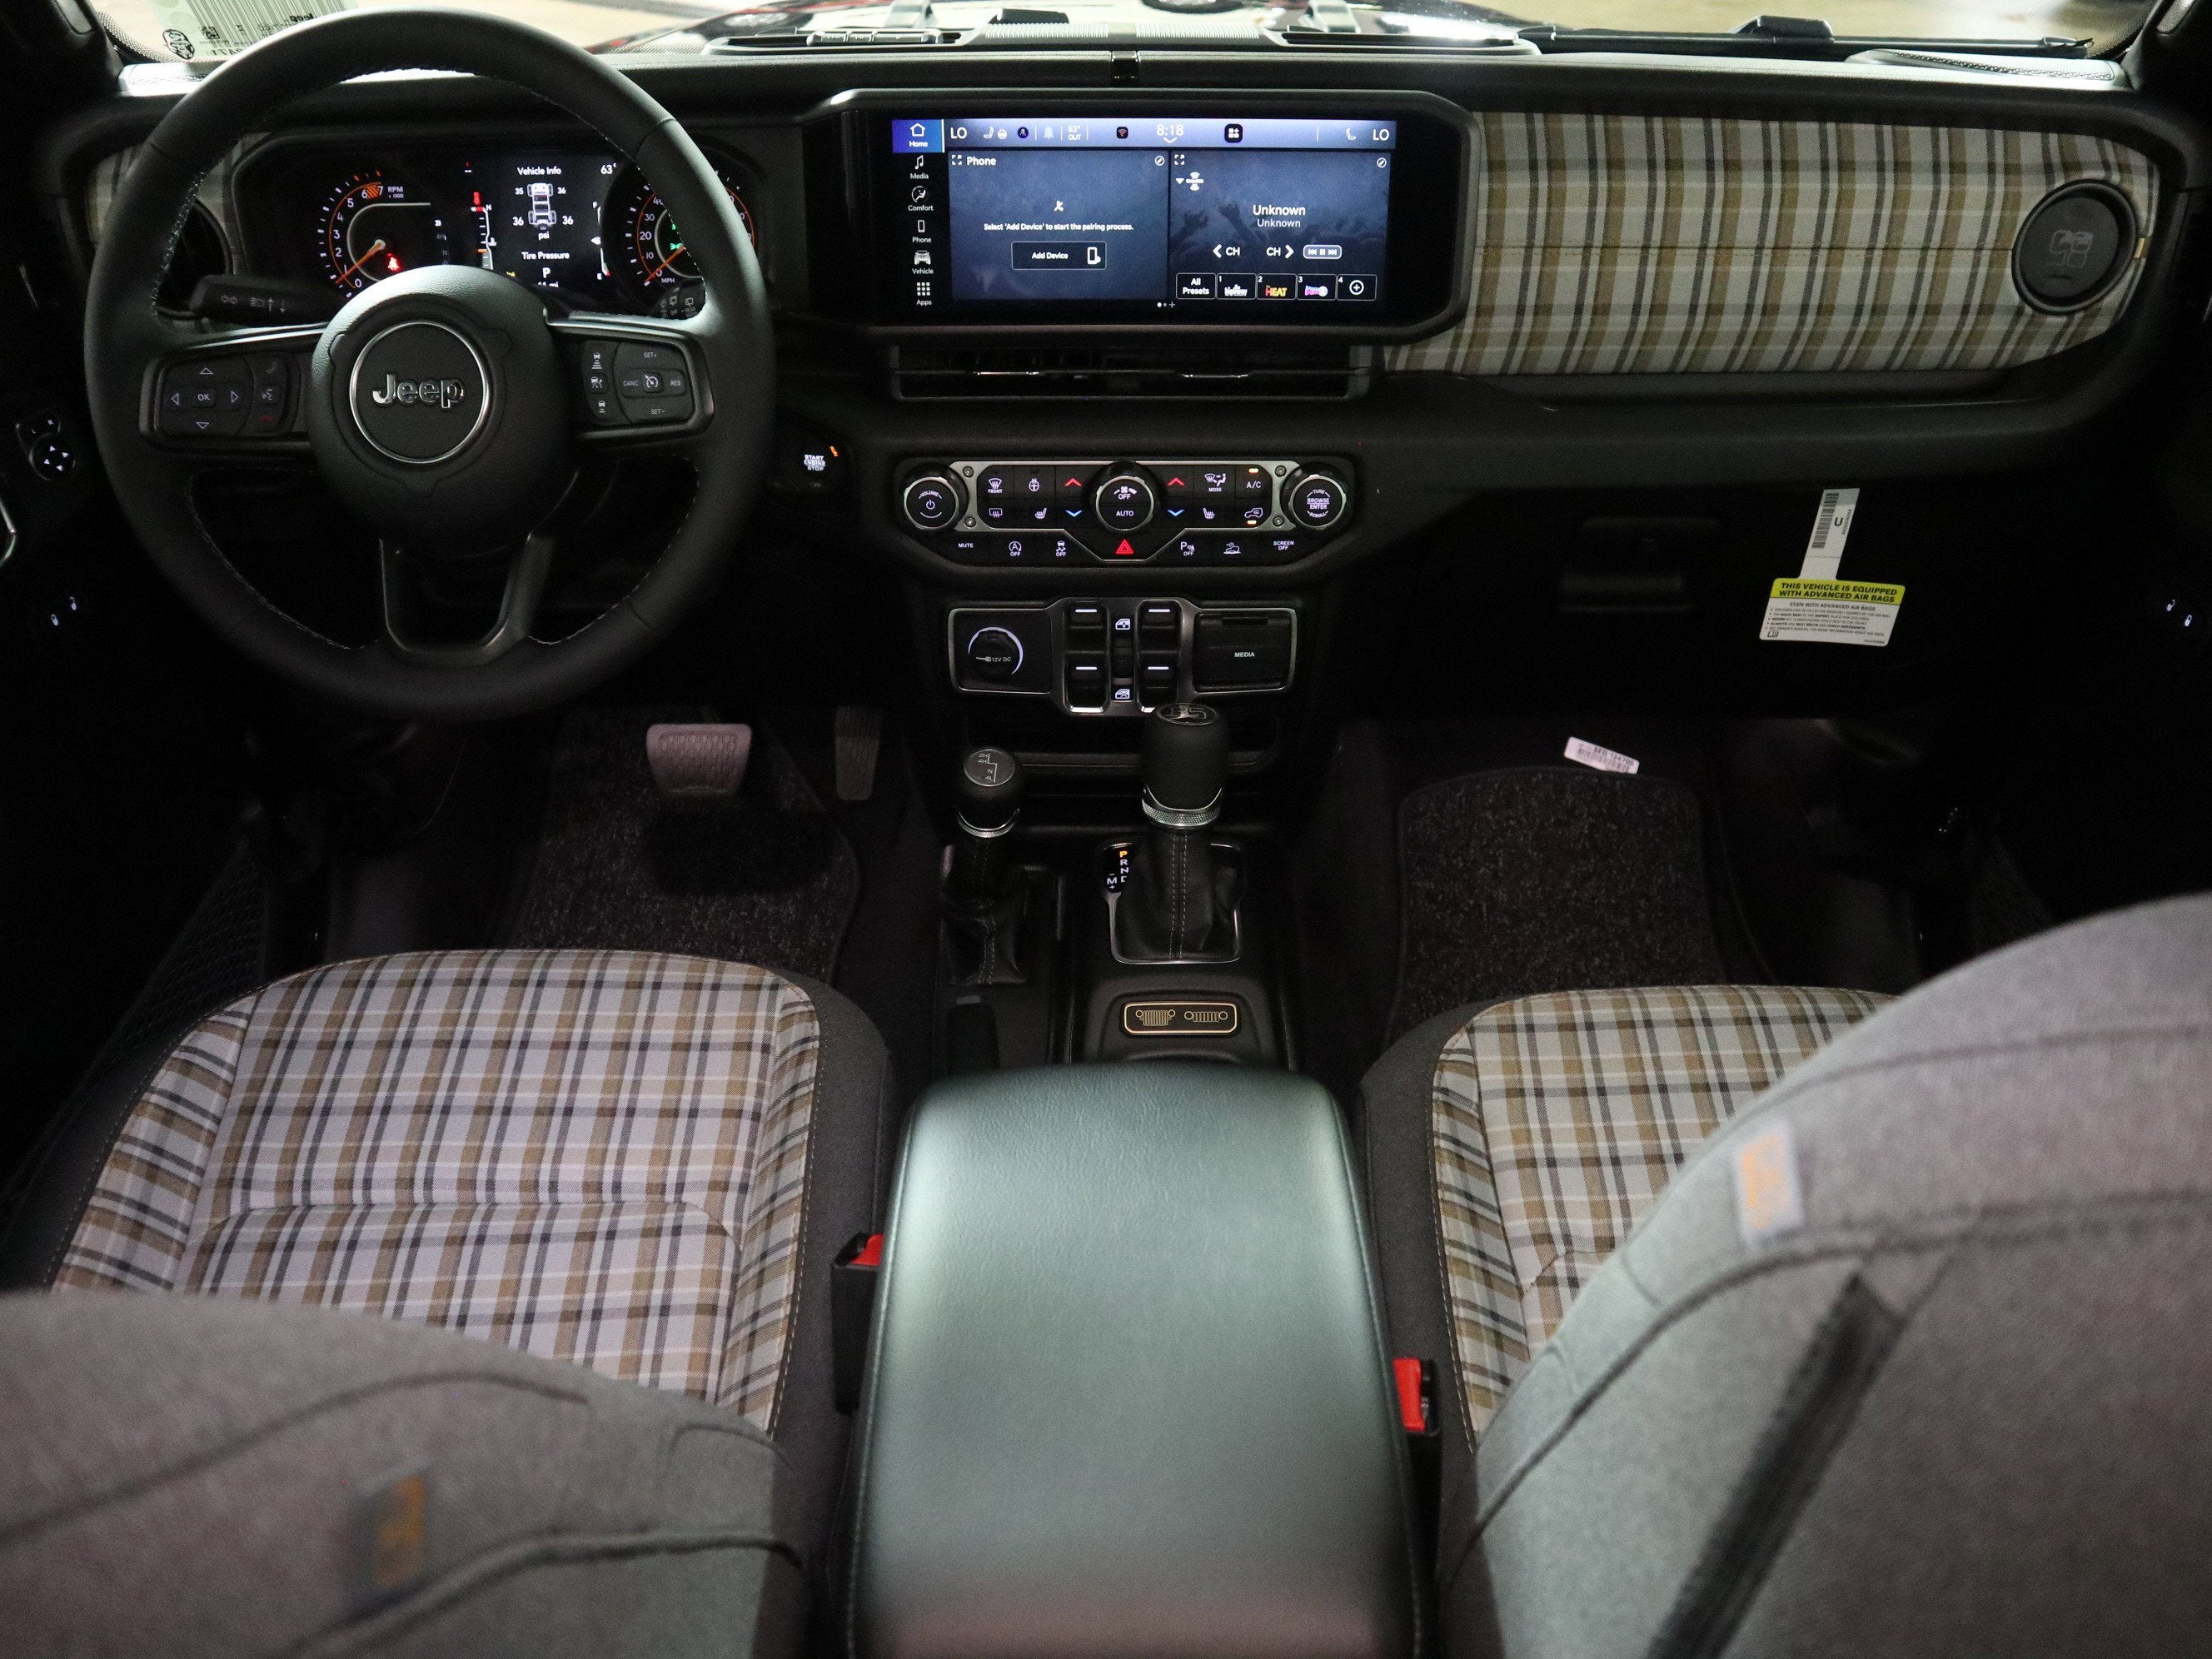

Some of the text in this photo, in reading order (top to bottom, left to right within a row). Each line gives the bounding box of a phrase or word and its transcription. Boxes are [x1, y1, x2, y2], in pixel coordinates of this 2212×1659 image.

[950, 127, 968, 139] LO
[1156, 124, 1184, 137] 8:18
[1373, 128, 1390, 141] LO
[966, 157, 997, 166] Phone
[517, 167, 562, 176] Vehicle Info
[361, 189, 368, 198] 6
[377, 186, 384, 195] 7
[347, 198, 354, 207] 5
[1253, 204, 1306, 216] Unknown
[336, 212, 344, 222] 4
[562, 216, 574, 226] 36
[512, 217, 524, 227] 36
[1257, 219, 1301, 227] Unknown
[333, 230, 340, 239] 3
[538, 232, 550, 241] psi
[640, 232, 652, 240] 20
[336, 248, 342, 257] 2
[521, 252, 570, 260] Tire Pressure
[1225, 247, 1240, 256] CH
[1266, 247, 1281, 256] CH
[542, 267, 551, 278] P
[355, 278, 362, 288] 0
[1190, 277, 1202, 286] All
[1183, 286, 1210, 295] Presets
[1265, 287, 1288, 296] HEAT
[372, 374, 464, 409] Jeep
[197, 393, 210, 401] OK
[1246, 481, 1262, 489] A/C
[1834, 517, 1843, 526] U
[1180, 542, 1187, 551] P
[1803, 583, 1839, 591] VEHICLE
[1852, 585, 1897, 595] EQUIPPED
[1803, 590, 1852, 600] ADVANCED
[1871, 595, 1895, 603] BAGS
